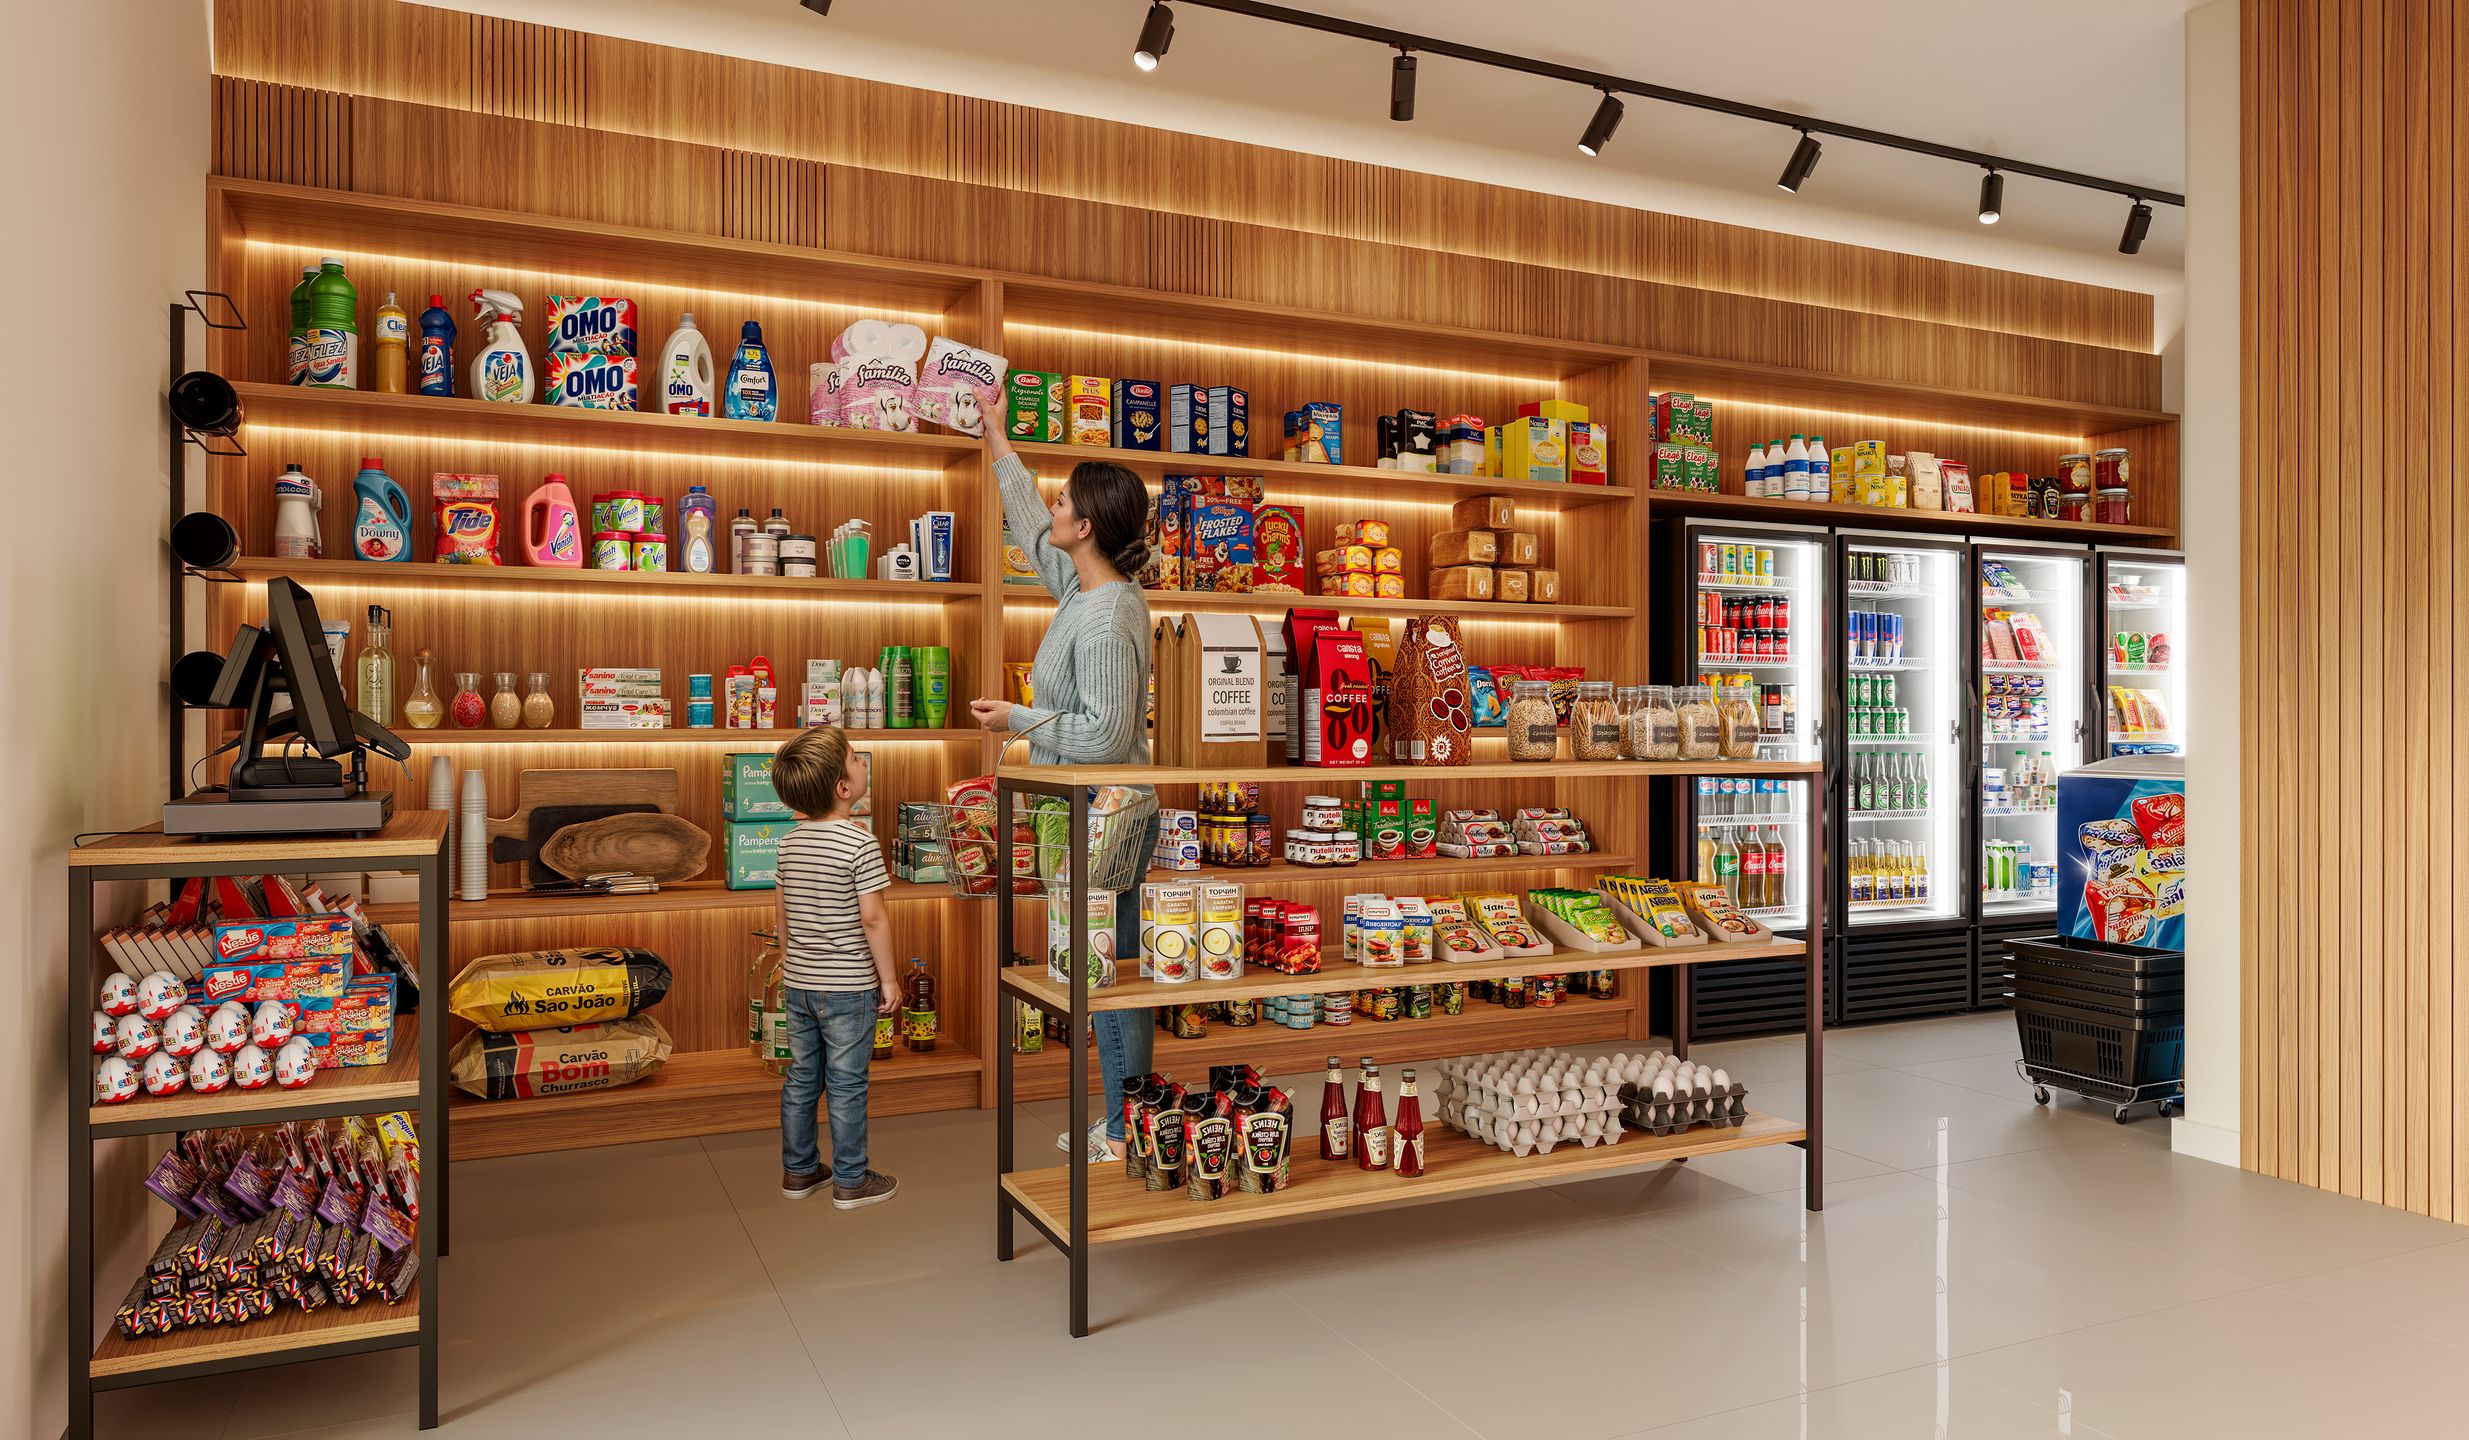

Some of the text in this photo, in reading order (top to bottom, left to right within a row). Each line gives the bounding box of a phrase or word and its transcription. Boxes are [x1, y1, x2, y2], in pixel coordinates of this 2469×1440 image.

[562, 306, 616, 340] OMO
[494, 364, 516, 382] VEJA
[857, 364, 911, 388] familia
[939, 353, 996, 386] familia
[566, 365, 623, 398] OMO
[740, 374, 766, 385] Comfort
[669, 383, 693, 396] OMO
[578, 392, 615, 402] MULTIAÇÃO
[1695, 408, 1710, 420] legê
[617, 505, 639, 522] Vanish
[447, 509, 492, 535] Tide
[1201, 516, 1243, 530] FROSTED
[1265, 521, 1288, 533] Lucky
[361, 527, 400, 540] Downy
[1202, 526, 1238, 539] FLAKES
[1261, 532, 1290, 544] Charms
[550, 532, 573, 555] Vanish
[1337, 644, 1362, 653] calista
[1208, 678, 1254, 686] ORGINAL BLEND
[1267, 681, 1286, 689] ORGIN
[1213, 690, 1251, 704] COFFEE
[1326, 694, 1367, 703] COFFEE
[1208, 708, 1256, 716] colombian coffee
[743, 798, 749, 806] 4
[739, 835, 779, 848] Pampers
[2151, 854, 2185, 871] Gala
[739, 867, 745, 875] 4
[1088, 893, 1108, 902] РЧИН
[1162, 889, 1191, 898] ТОРЧИН
[1208, 888, 1237, 896] ТОРЧИН
[222, 932, 260, 952] Nestlé
[209, 973, 247, 992] Nestlé
[546, 983, 595, 996] CARVÃO
[534, 994, 616, 1013] Sao João
[559, 1050, 608, 1064] Carvão
[541, 1060, 610, 1084] Bom
[540, 1077, 609, 1094] Churrasco
